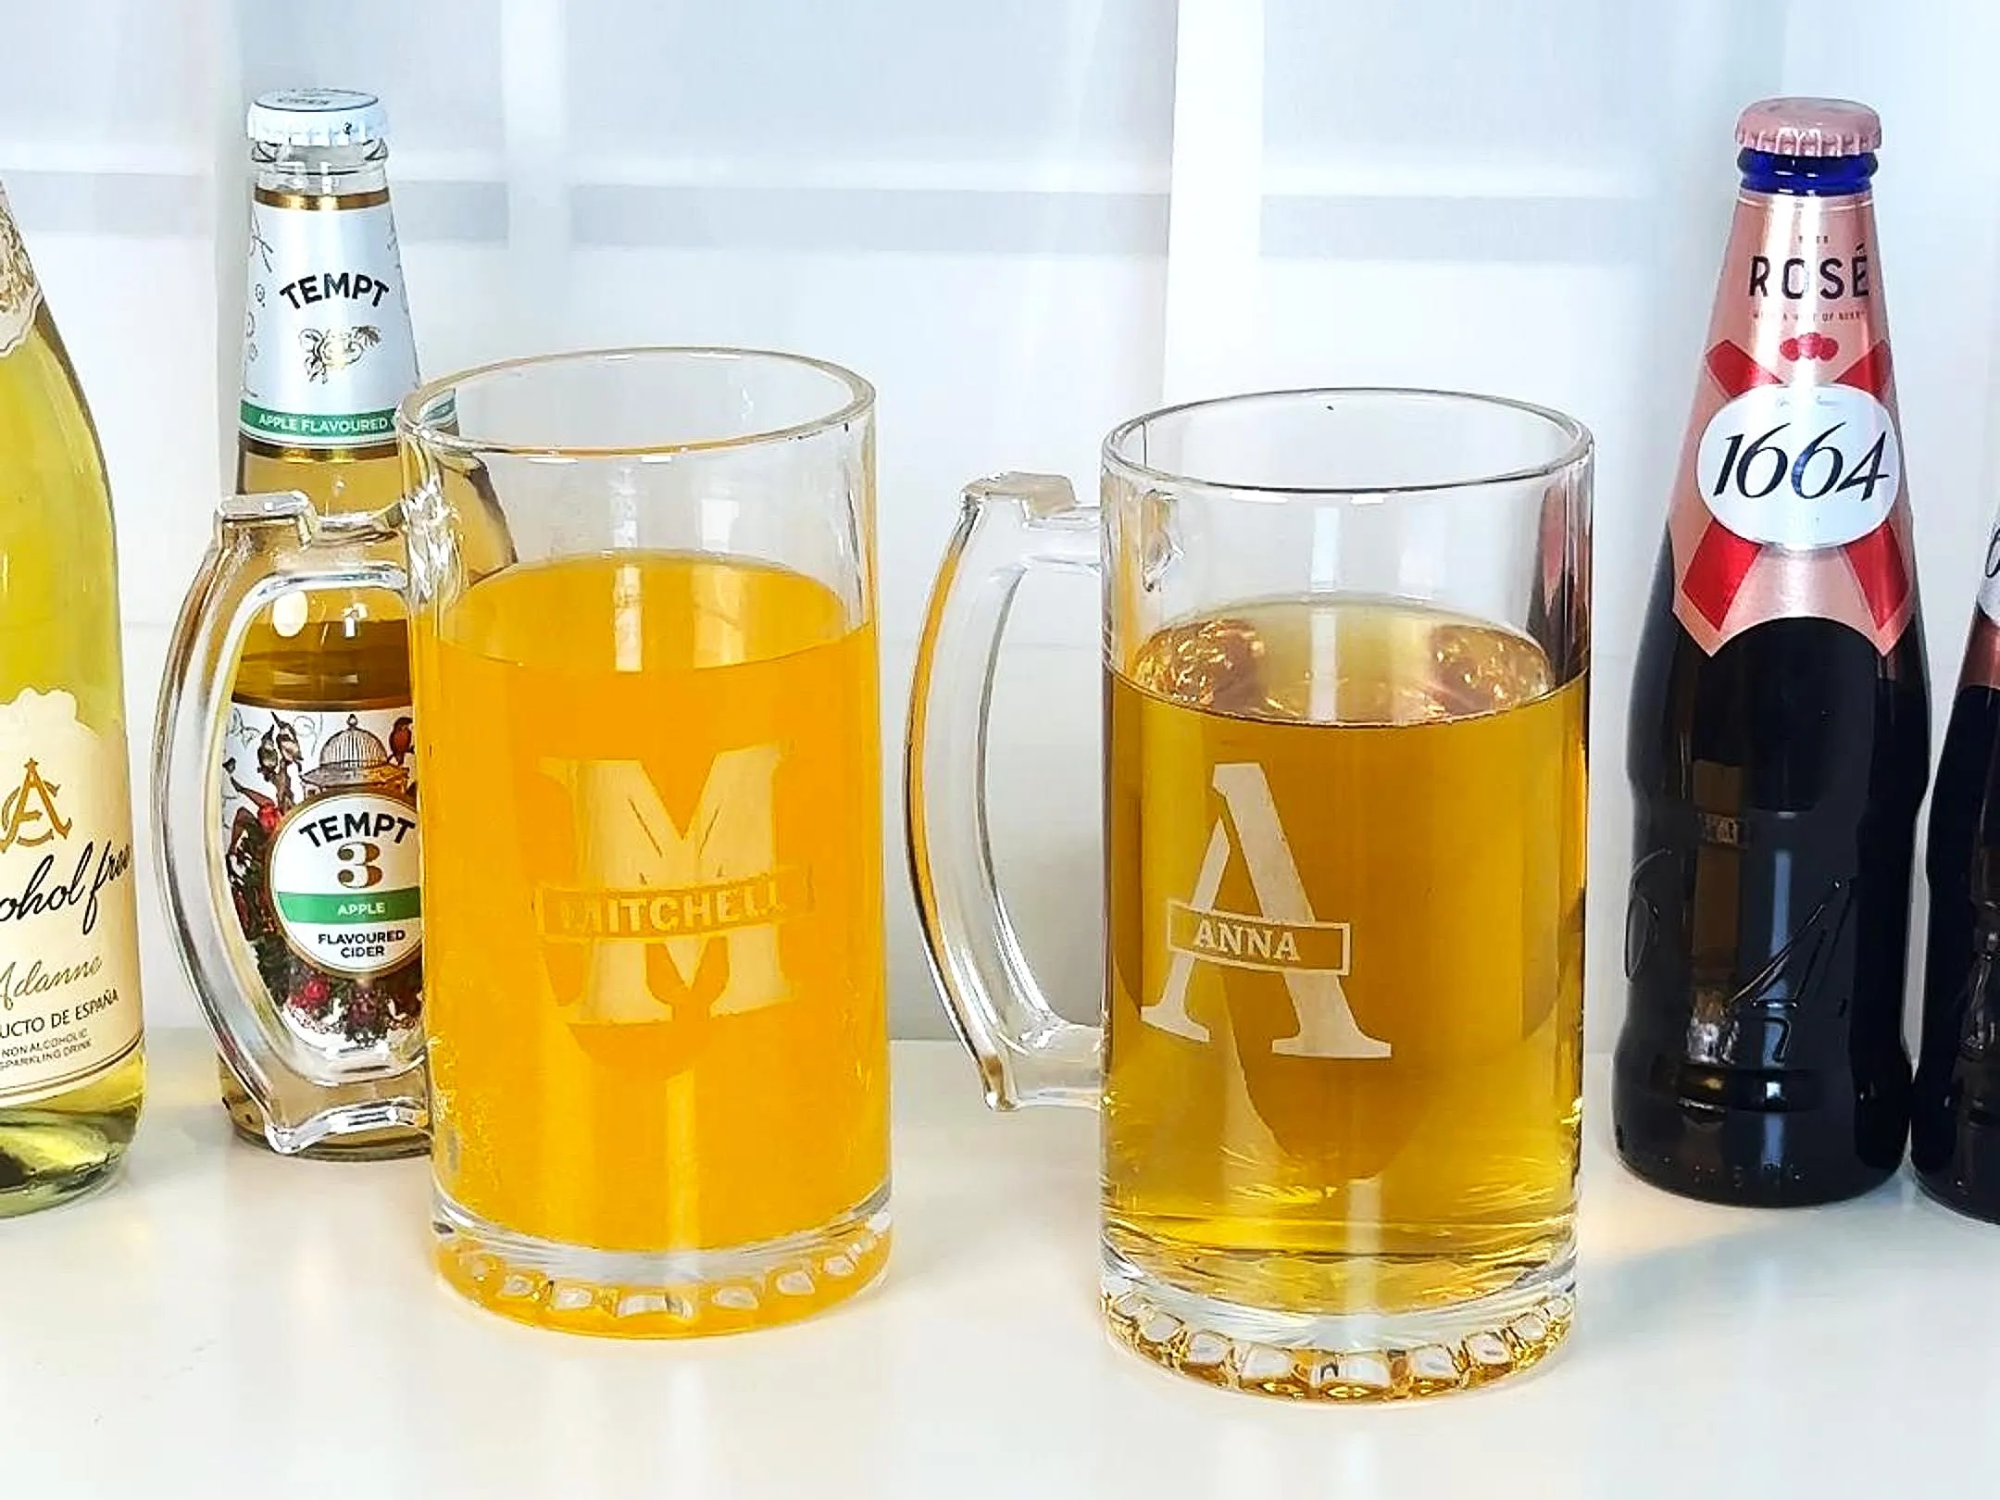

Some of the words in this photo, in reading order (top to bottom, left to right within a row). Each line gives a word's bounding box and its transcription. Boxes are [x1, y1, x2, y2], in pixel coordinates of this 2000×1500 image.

[279, 272, 390, 310] TEMPT
[1748, 242, 1870, 300] ROSÉ
[258, 413, 298, 431] APPLE
[301, 415, 388, 433] FLAVOURED
[1712, 421, 1890, 502] 1664
[298, 811, 416, 848] TEMPT
[336, 841, 383, 889] 3
[536, 738, 799, 1027] M
[337, 901, 386, 917] APPLE
[559, 880, 788, 934] MITCHELL
[1140, 762, 1392, 1059] A
[317, 929, 406, 945] FLAVOURED
[340, 946, 386, 959] CIDER
[1193, 919, 1301, 963] ANNA
[51, 1009, 71, 1030] DE
[75, 988, 120, 1021] ESPAÑA
[1, 1045, 28, 1059] NON
[29, 1028, 88, 1052] ALCOHOLIC
[62, 1038, 93, 1057] DRINK
